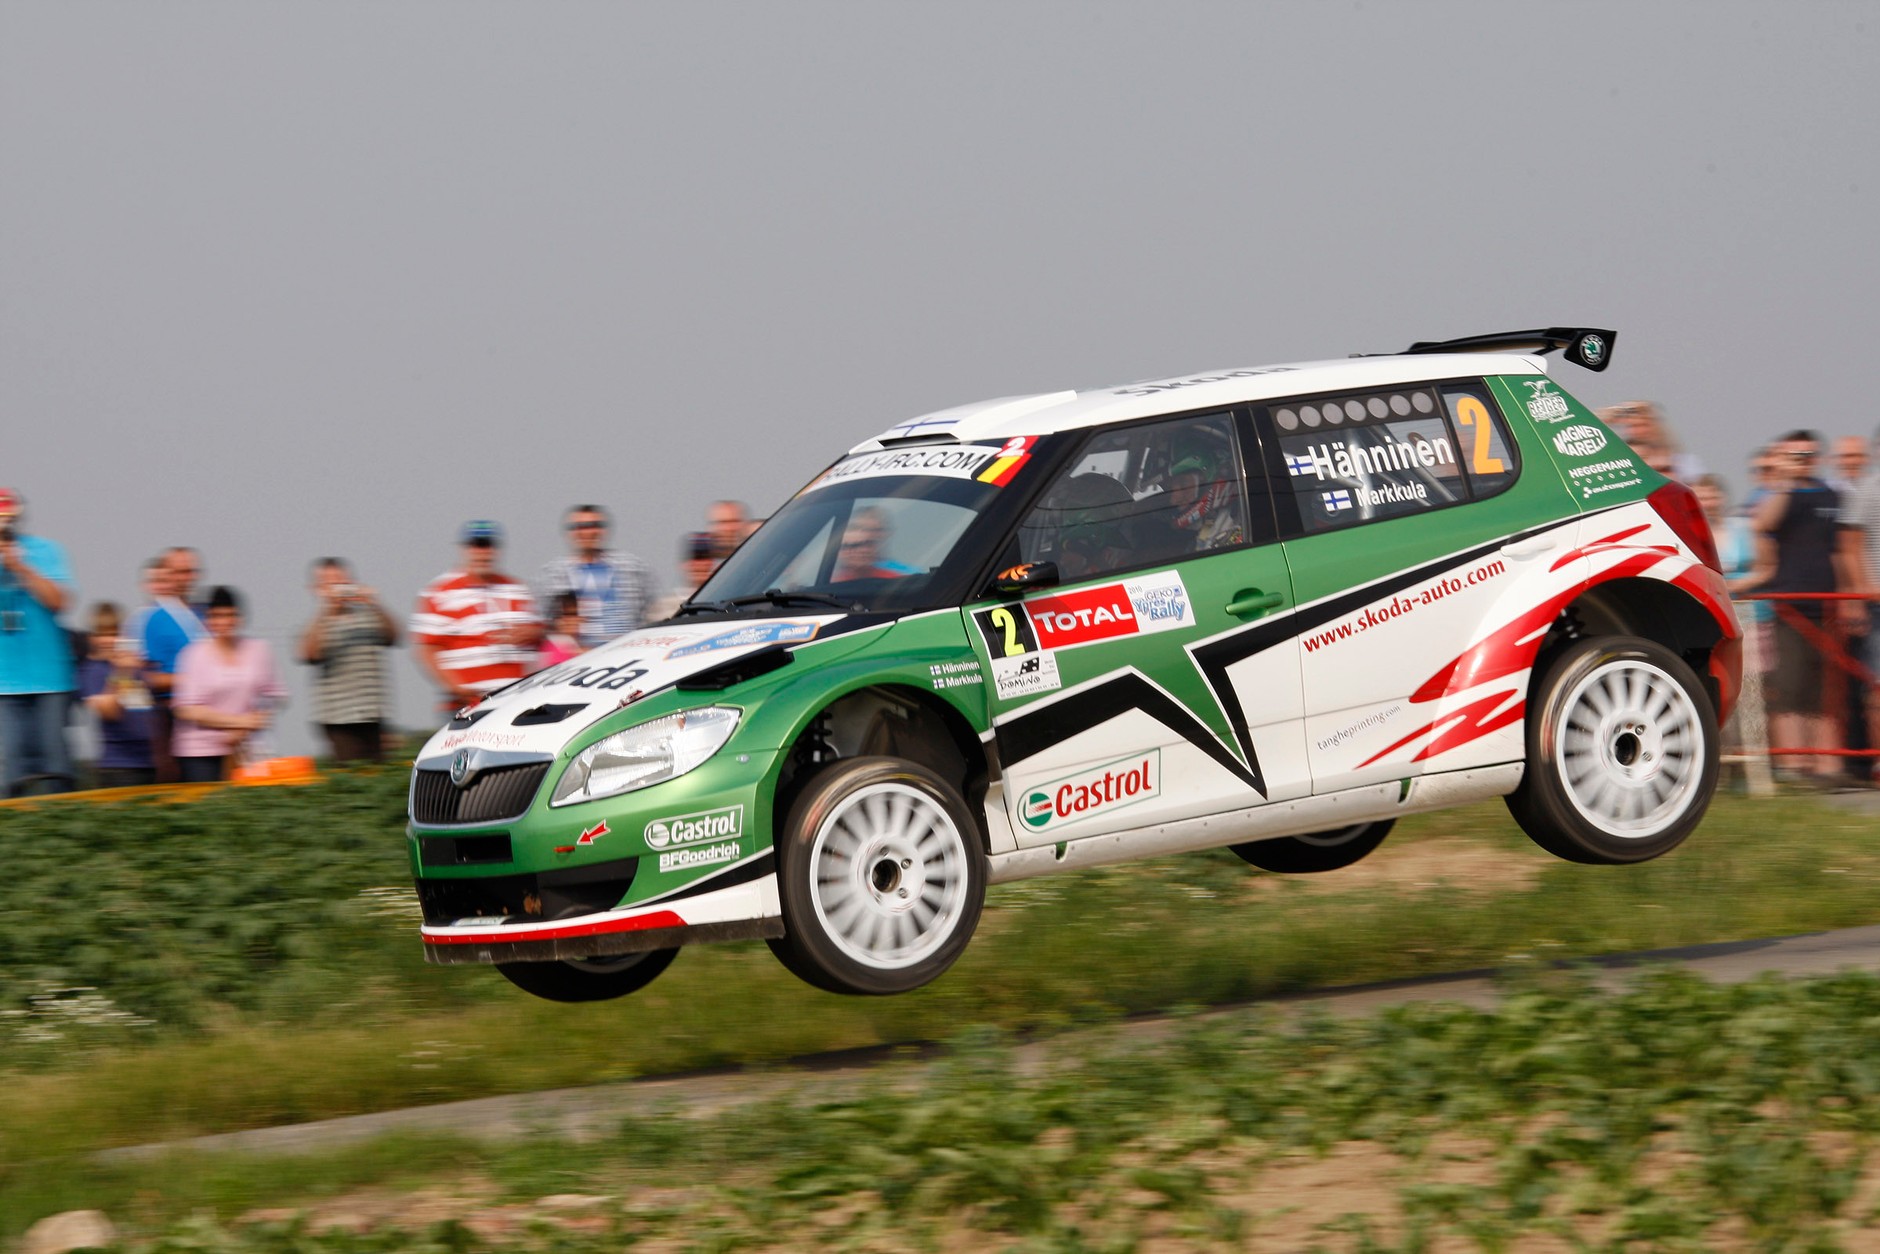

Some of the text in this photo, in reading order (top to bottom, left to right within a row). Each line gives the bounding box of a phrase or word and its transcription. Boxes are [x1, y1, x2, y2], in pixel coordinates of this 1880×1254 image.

[998, 437, 1026, 457] 2
[1456, 397, 1505, 474] 2
[1308, 434, 1456, 482] Hänninen
[1568, 458, 1633, 478] HEGGEMANN
[1354, 480, 1428, 507] Markkula
[1146, 588, 1173, 600] GEKO
[1149, 597, 1185, 621] Rally
[1303, 560, 1506, 653] www.skoda-auto.com
[991, 608, 1025, 657] 2
[1033, 603, 1134, 634] TOTAL
[1317, 704, 1401, 751] tangheprinting.com
[1056, 760, 1153, 818] Castrol
[671, 811, 737, 844] Castrol
[659, 841, 740, 868] BFGoodrich
